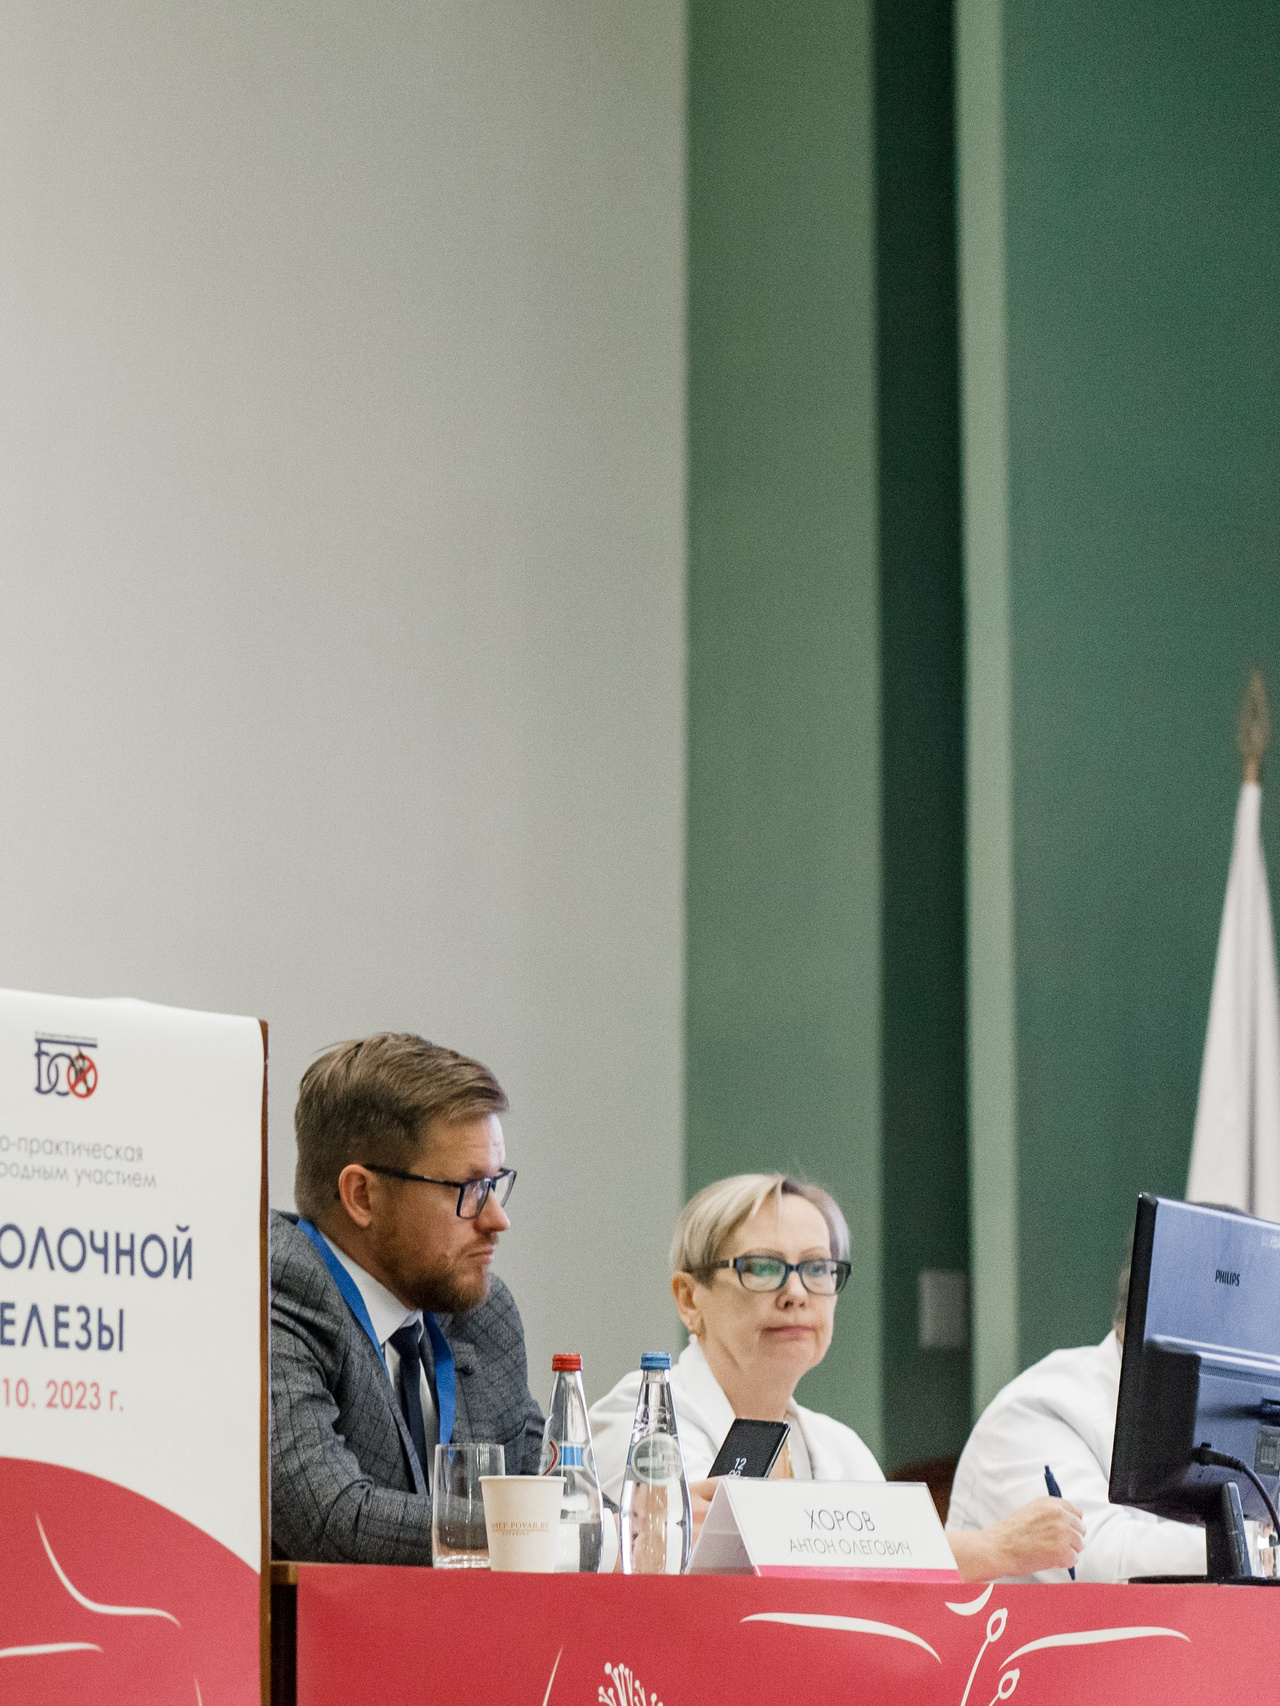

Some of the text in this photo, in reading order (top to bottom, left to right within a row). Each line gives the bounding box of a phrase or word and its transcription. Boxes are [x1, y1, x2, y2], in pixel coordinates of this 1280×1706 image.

[74, 1166, 158, 1188] участием
[1215, 1269, 1241, 1287] PHILIPS
[46, 1379, 101, 1412] 2023
[734, 1457, 747, 1471] 12
[804, 1508, 876, 1532] ХОРОВ
[789, 1537, 913, 1556] АНТОН ОЛЕГОВИЧ
